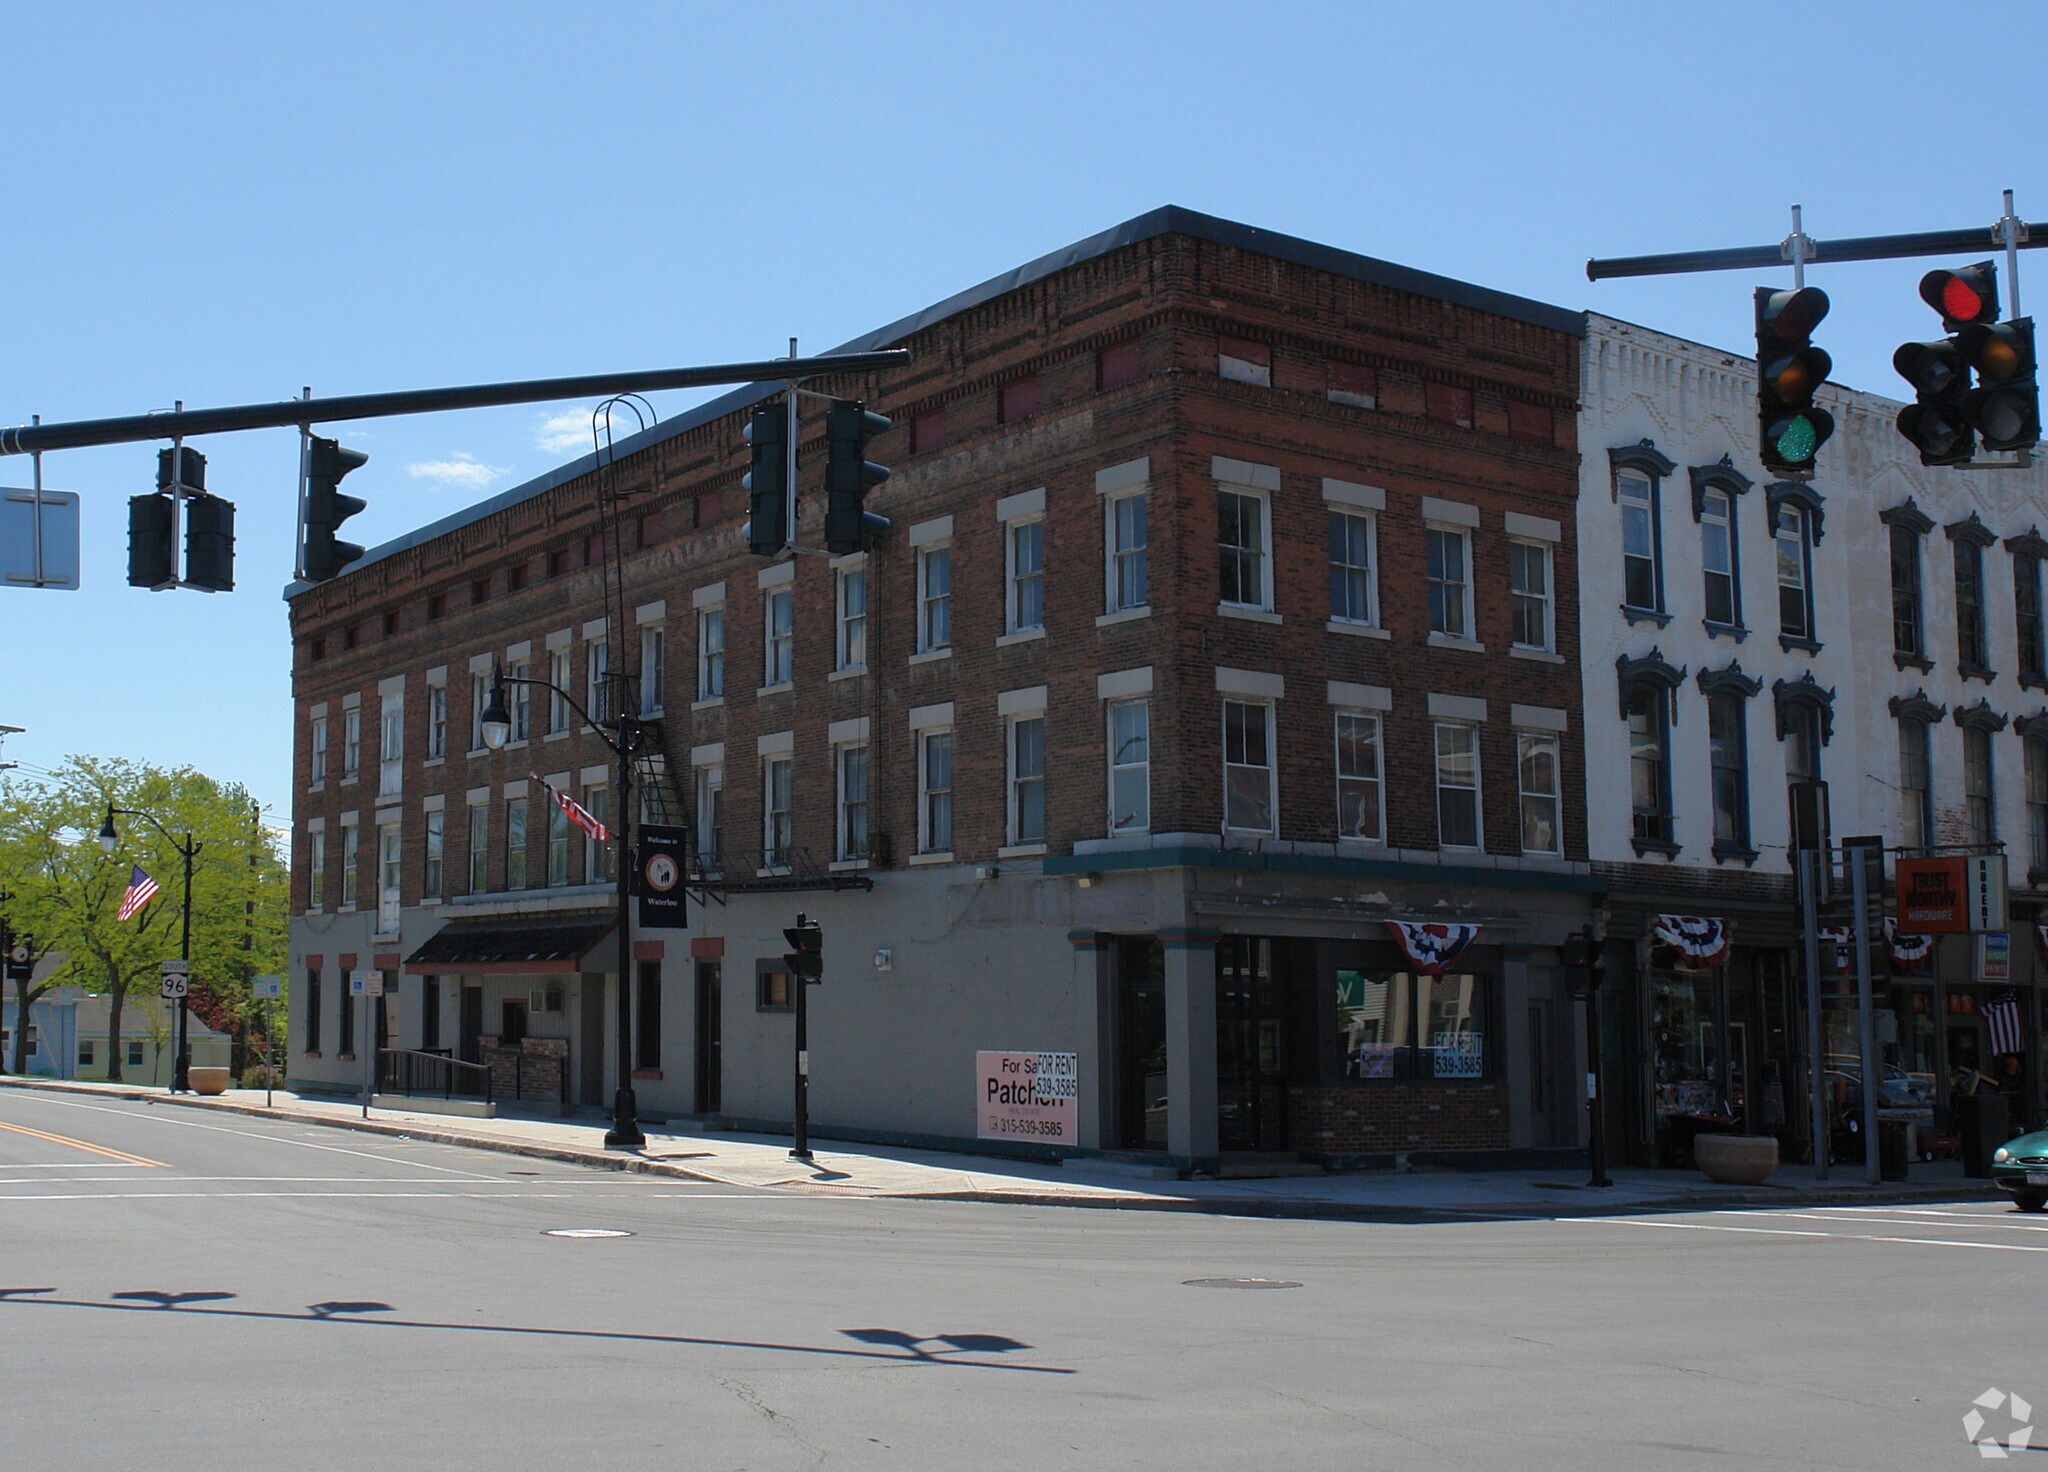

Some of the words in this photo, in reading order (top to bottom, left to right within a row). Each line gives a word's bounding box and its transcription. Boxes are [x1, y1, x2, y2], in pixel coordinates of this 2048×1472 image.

[1912, 872, 1949, 890] TRUST
[647, 897, 678, 906] Waterloo
[1906, 891, 1955, 907] WORTHY
[1908, 909, 1953, 921] HARDWARE
[164, 962, 186, 970] SOUTH
[165, 979, 185, 993] 96
[1002, 1058, 1021, 1073] For
[1024, 1058, 1037, 1074] Sa
[1037, 1054, 1054, 1075] FOR
[1055, 1055, 1076, 1075] RENT
[1434, 1056, 1482, 1075] 539-3585
[1036, 1077, 1076, 1097] 539-3585
[1000, 1118, 1062, 1136] 315-539-3585
